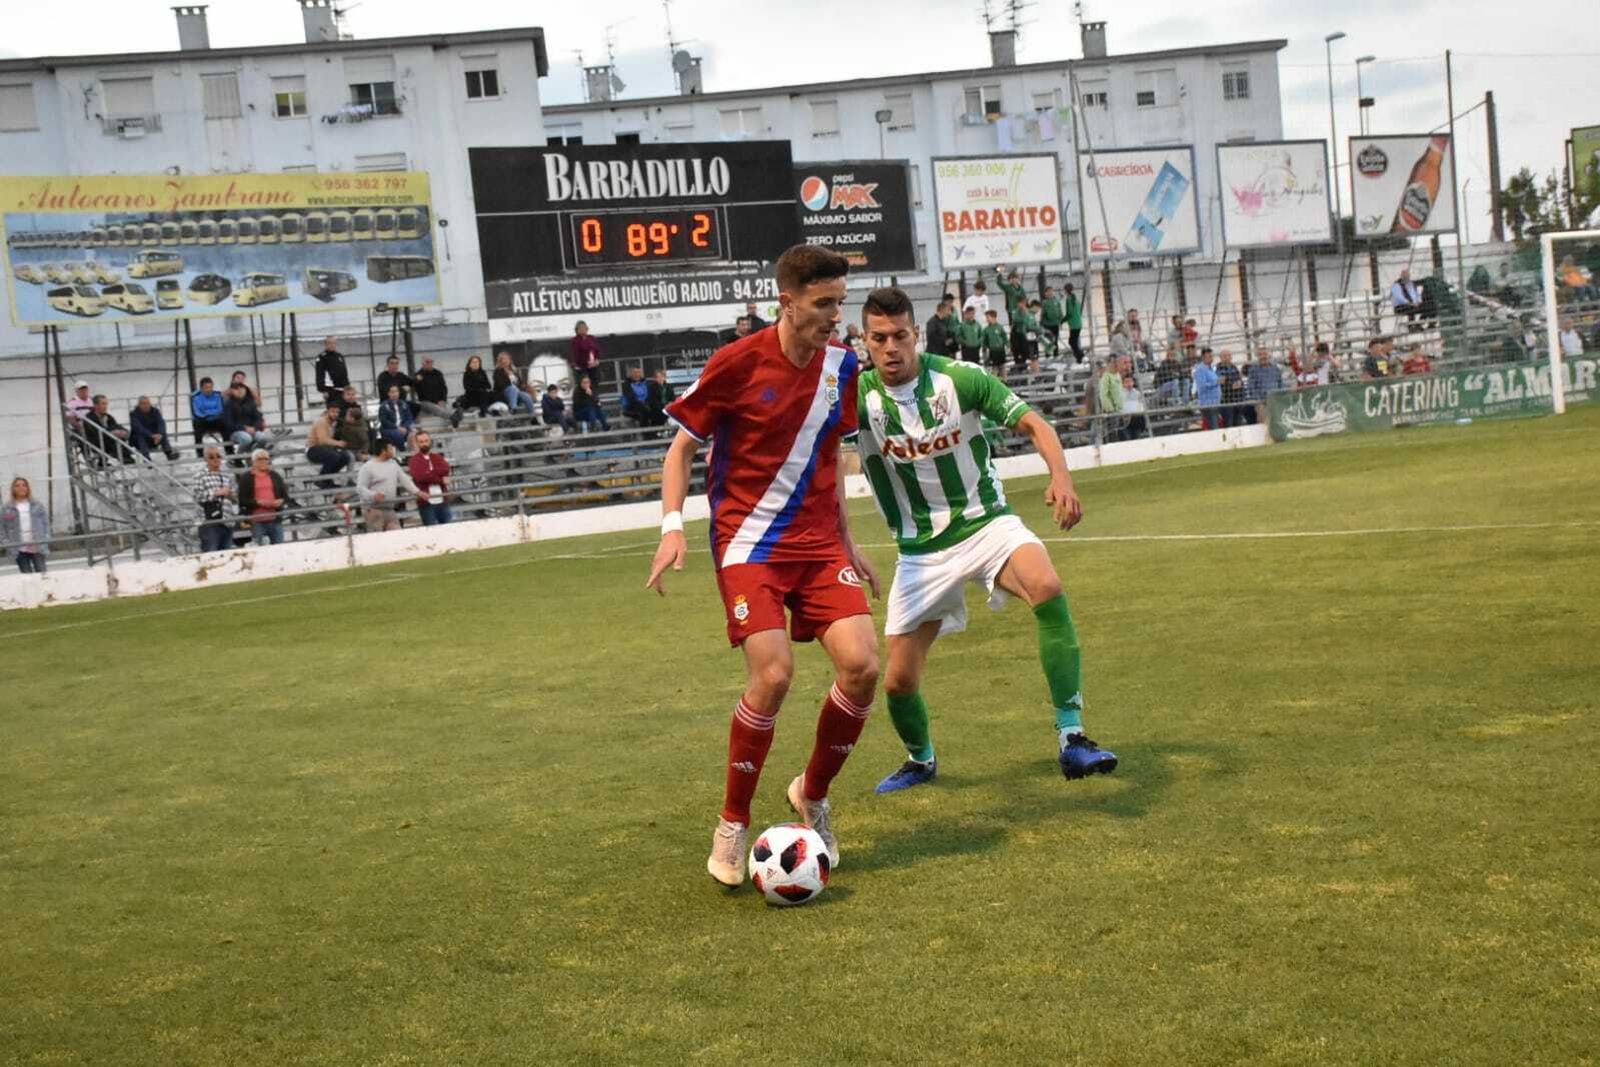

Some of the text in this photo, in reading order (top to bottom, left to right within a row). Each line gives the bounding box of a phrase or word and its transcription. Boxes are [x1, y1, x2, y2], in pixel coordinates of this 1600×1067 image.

[543, 153, 730, 201] BARBADILLO
[581, 218, 603, 253] 0
[691, 213, 711, 248] 2
[942, 205, 1056, 232] BARATITO
[513, 287, 581, 313] ATLÉTICO
[584, 281, 677, 308] SANLUQUEÑO
[680, 280, 723, 303] RADIO
[1364, 376, 1459, 417] CATERING
